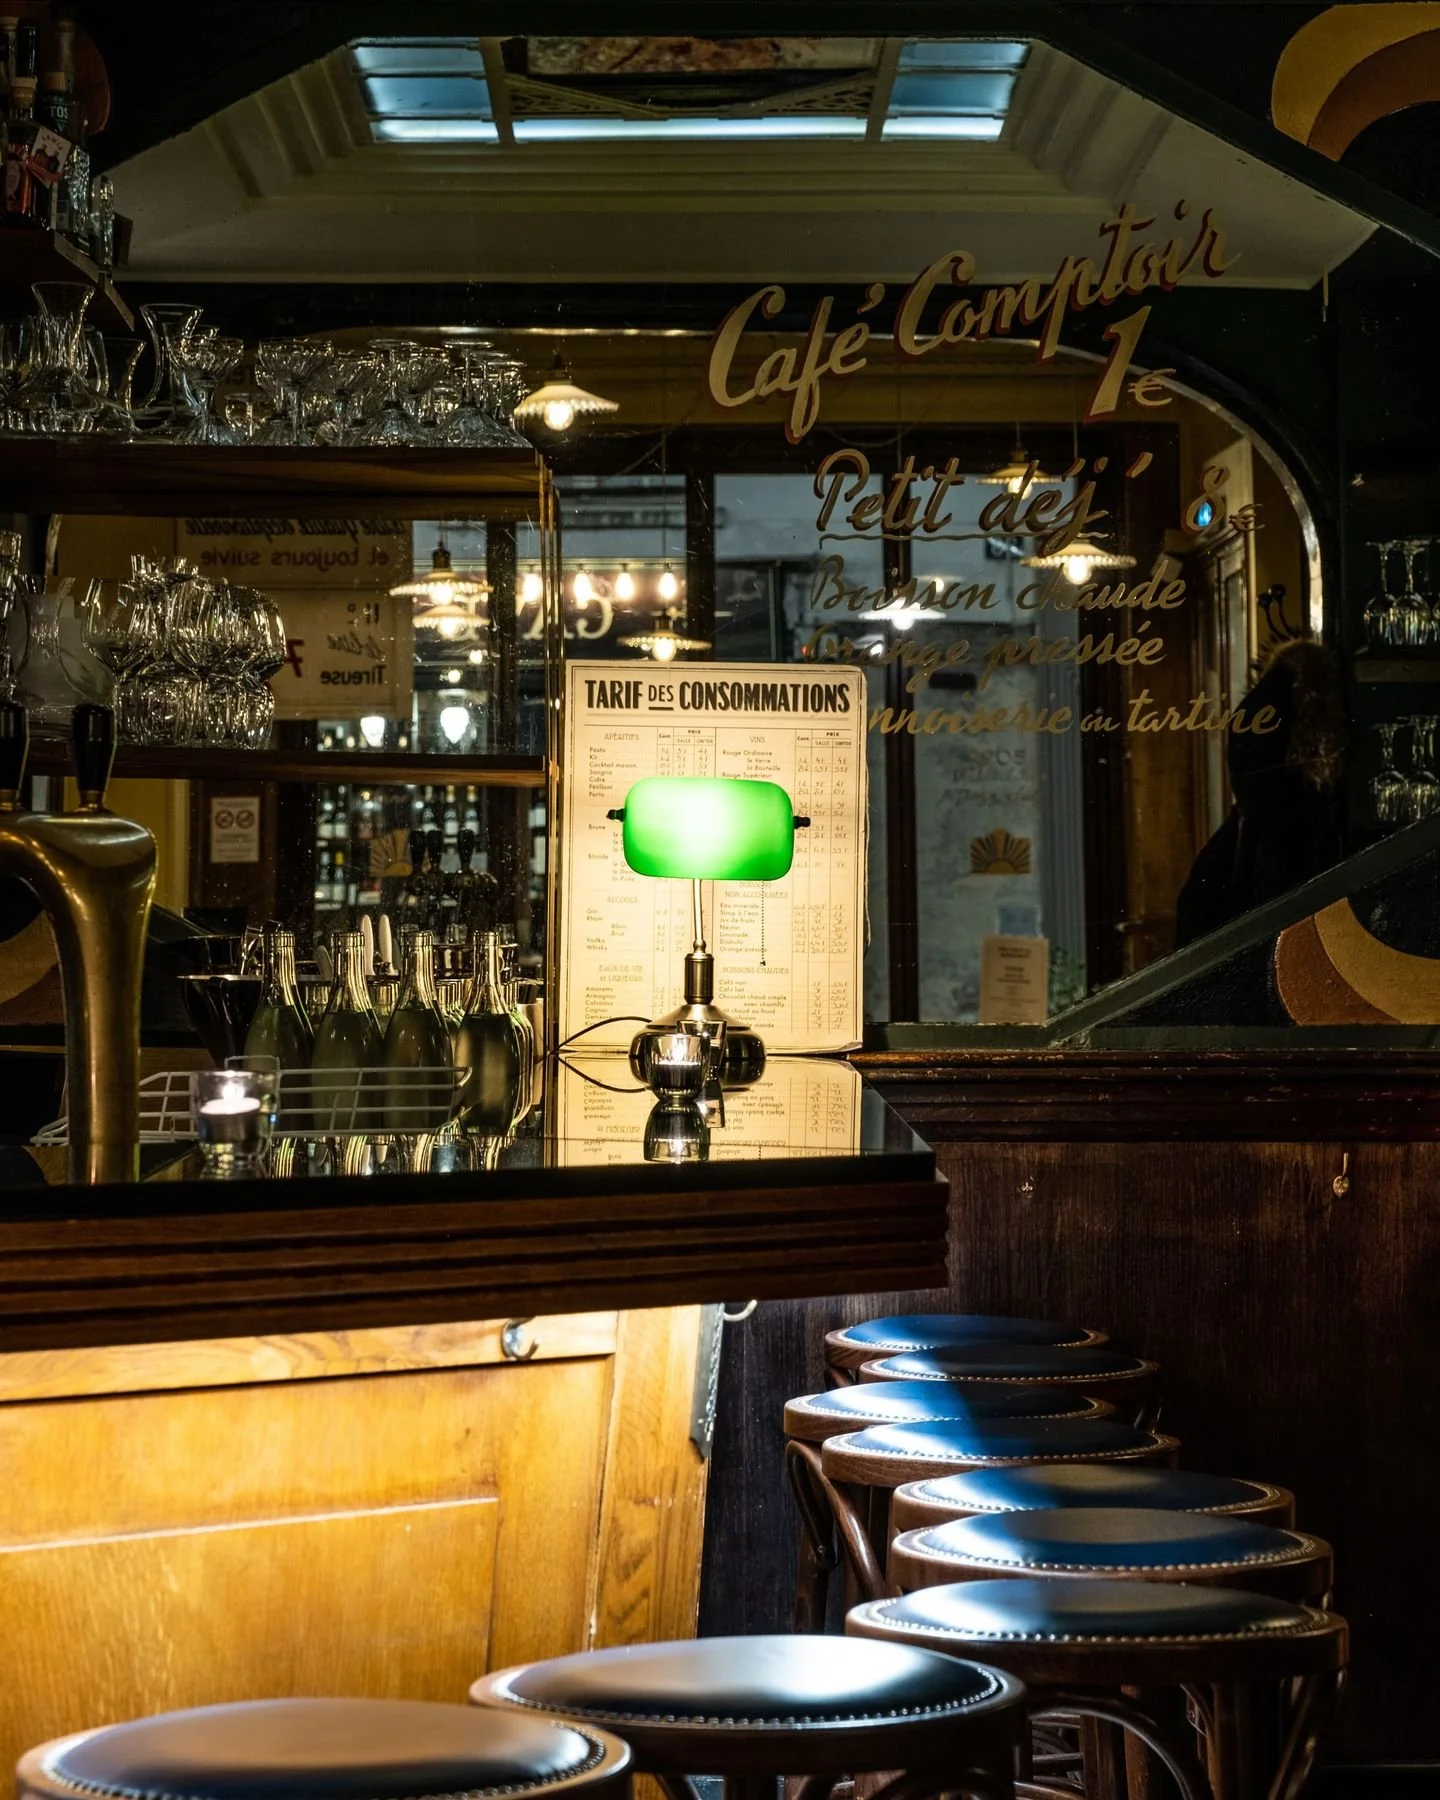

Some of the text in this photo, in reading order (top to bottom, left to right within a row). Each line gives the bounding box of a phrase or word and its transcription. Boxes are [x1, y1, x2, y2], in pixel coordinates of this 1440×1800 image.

[708, 198, 1240, 444] Café Comptoir
[813, 448, 964, 533] Petit
[810, 554, 1187, 611] Boisson chaude
[979, 621, 1166, 690] pressée
[585, 680, 851, 713] TARIF DES CONSOMMATIONS
[868, 688, 1282, 736] nnoiserie ou tartine
[750, 736, 766, 744] VINS
